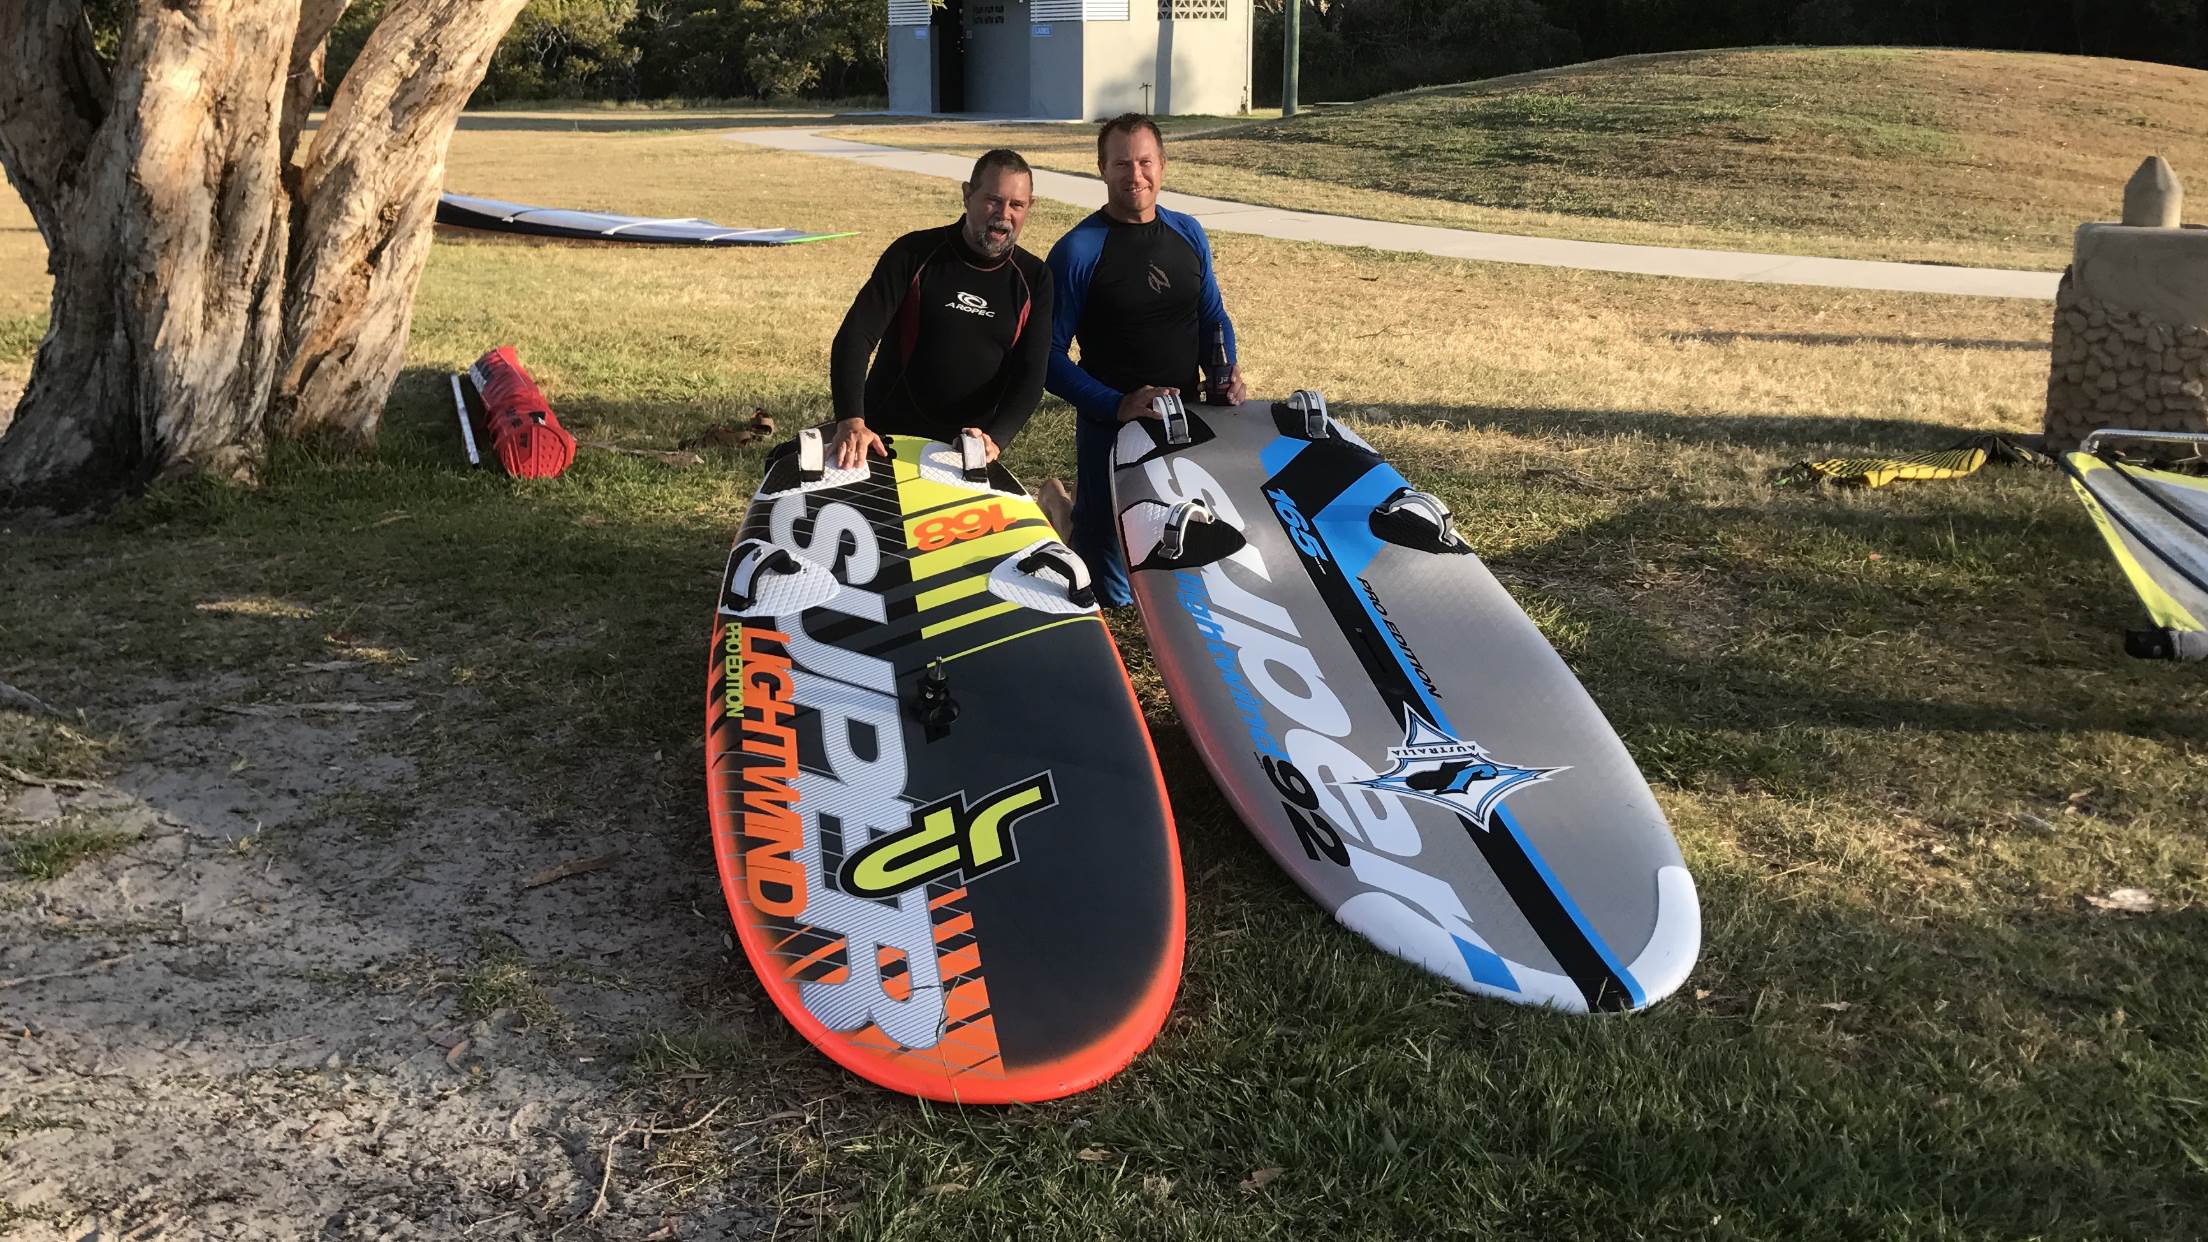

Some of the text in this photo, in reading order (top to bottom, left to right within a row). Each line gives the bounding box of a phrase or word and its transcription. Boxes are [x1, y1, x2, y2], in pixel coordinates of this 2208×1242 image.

[944, 302, 996, 318] AROPEC
[913, 503, 1018, 552] 168
[1267, 487, 1329, 562] 165
[725, 622, 745, 718] PRO EDITION
[1356, 576, 1442, 699] PRO EDITION
[741, 626, 808, 918] LIGHTWIND
[769, 493, 947, 1050] SUPER
[1391, 744, 1476, 757] AUSTRALIA
[848, 781, 1047, 893] JP
[1263, 755, 1351, 867] 92
